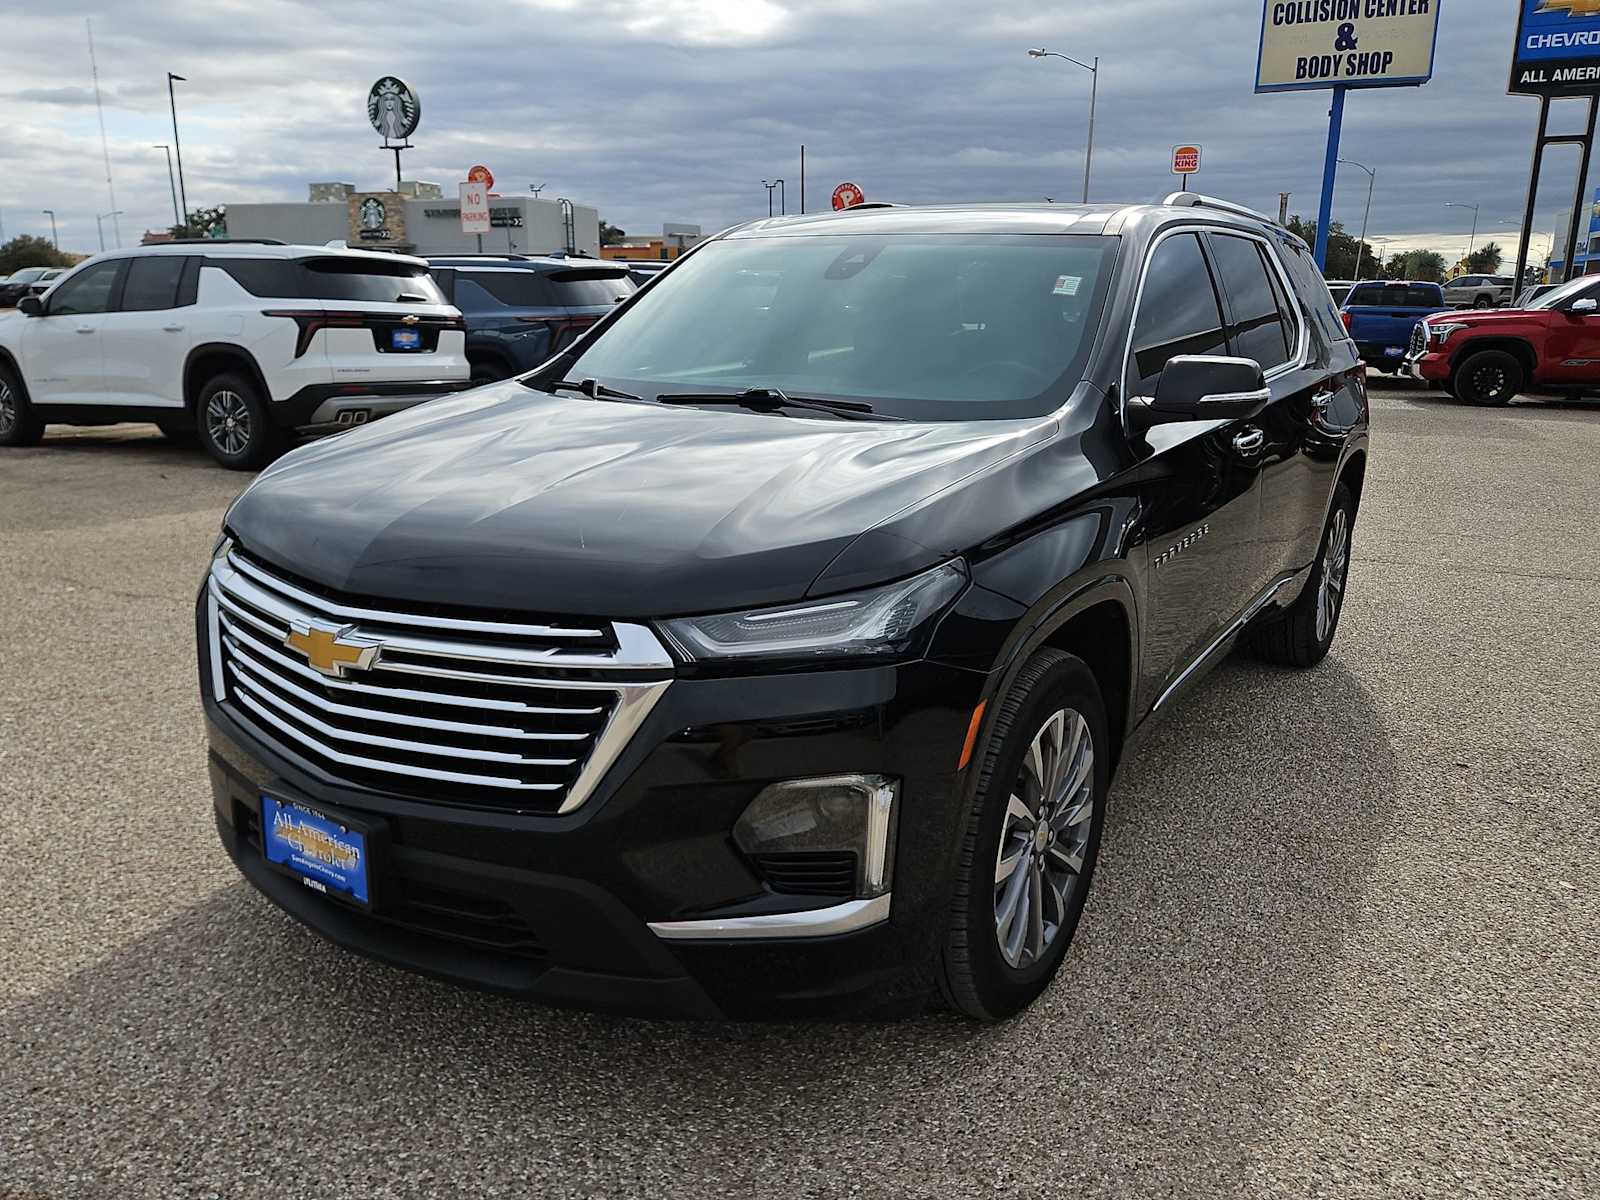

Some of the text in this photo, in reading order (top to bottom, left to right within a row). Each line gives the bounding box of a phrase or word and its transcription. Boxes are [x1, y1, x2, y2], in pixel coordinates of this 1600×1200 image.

[1273, 0, 1430, 26] COLLISION CENTER
[1334, 22, 1359, 52] &
[1526, 30, 1600, 49] CHEVRO
[1295, 51, 1393, 80] BODY SHOP
[1520, 69, 1548, 83] ALL
[1175, 160, 1198, 168] KING
[466, 192, 480, 205] NO
[462, 212, 488, 222] PARKING
[1154, 523, 1209, 569] TRAVERSE
[273, 810, 360, 860] All American
[287, 832, 347, 871] Chevrolet
